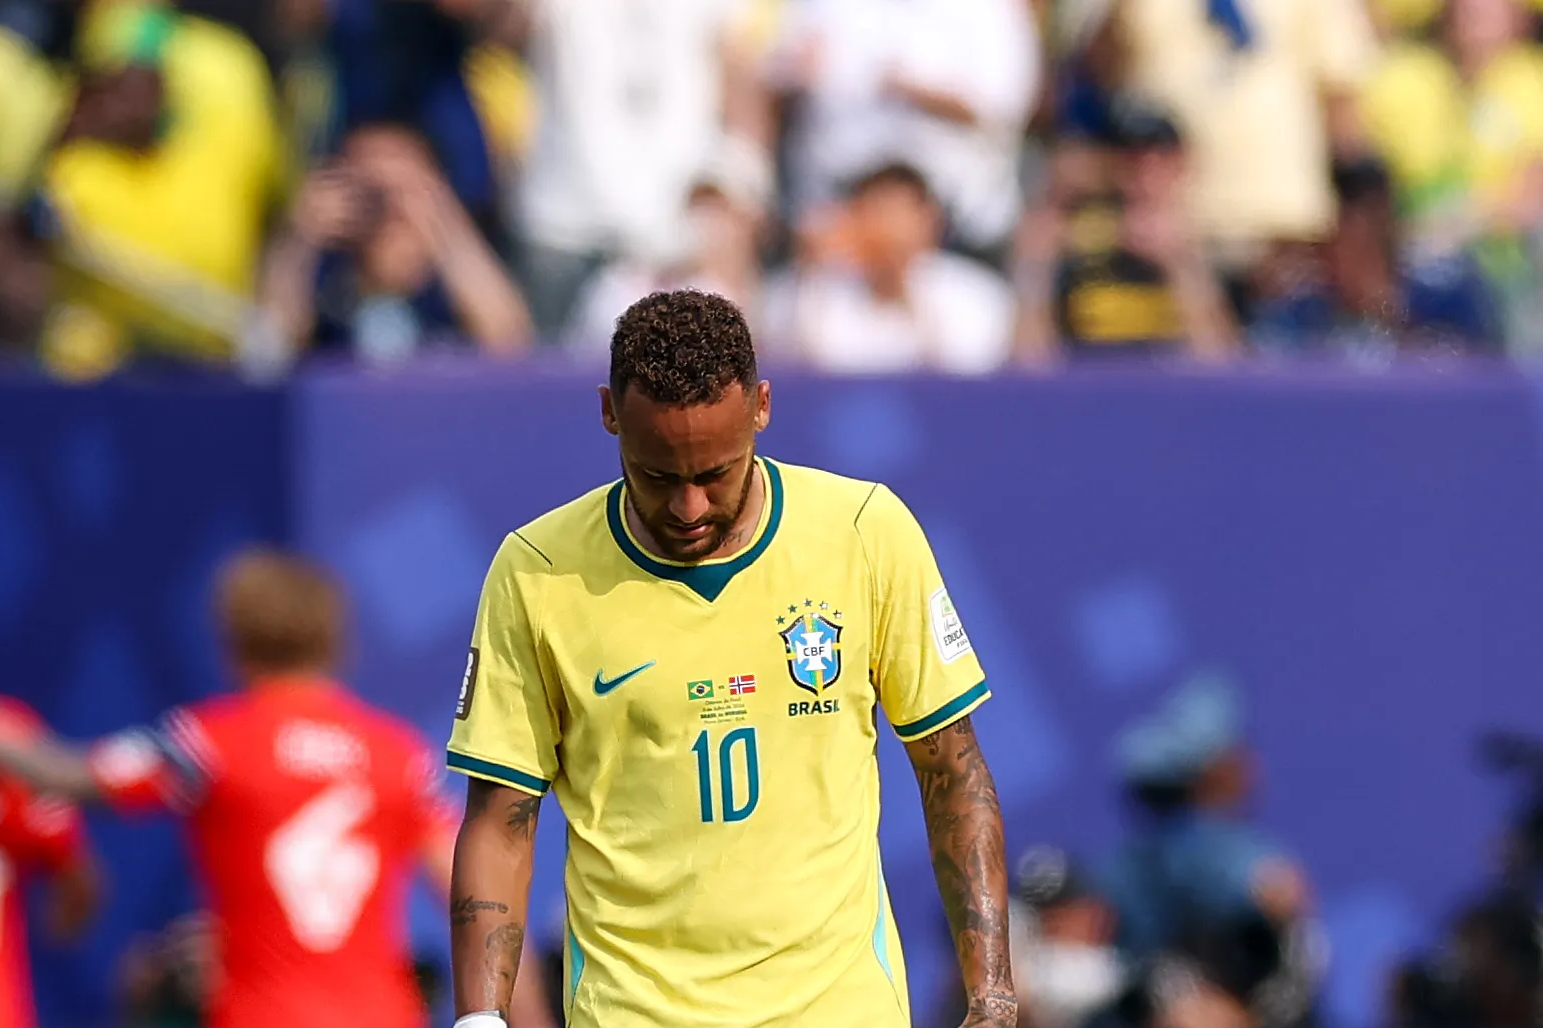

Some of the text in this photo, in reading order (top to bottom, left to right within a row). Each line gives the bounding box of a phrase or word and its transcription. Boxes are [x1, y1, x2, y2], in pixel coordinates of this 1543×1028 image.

[803, 646, 825, 657] CBF
[788, 699, 840, 717] BRASIL
[690, 727, 759, 823] 10
